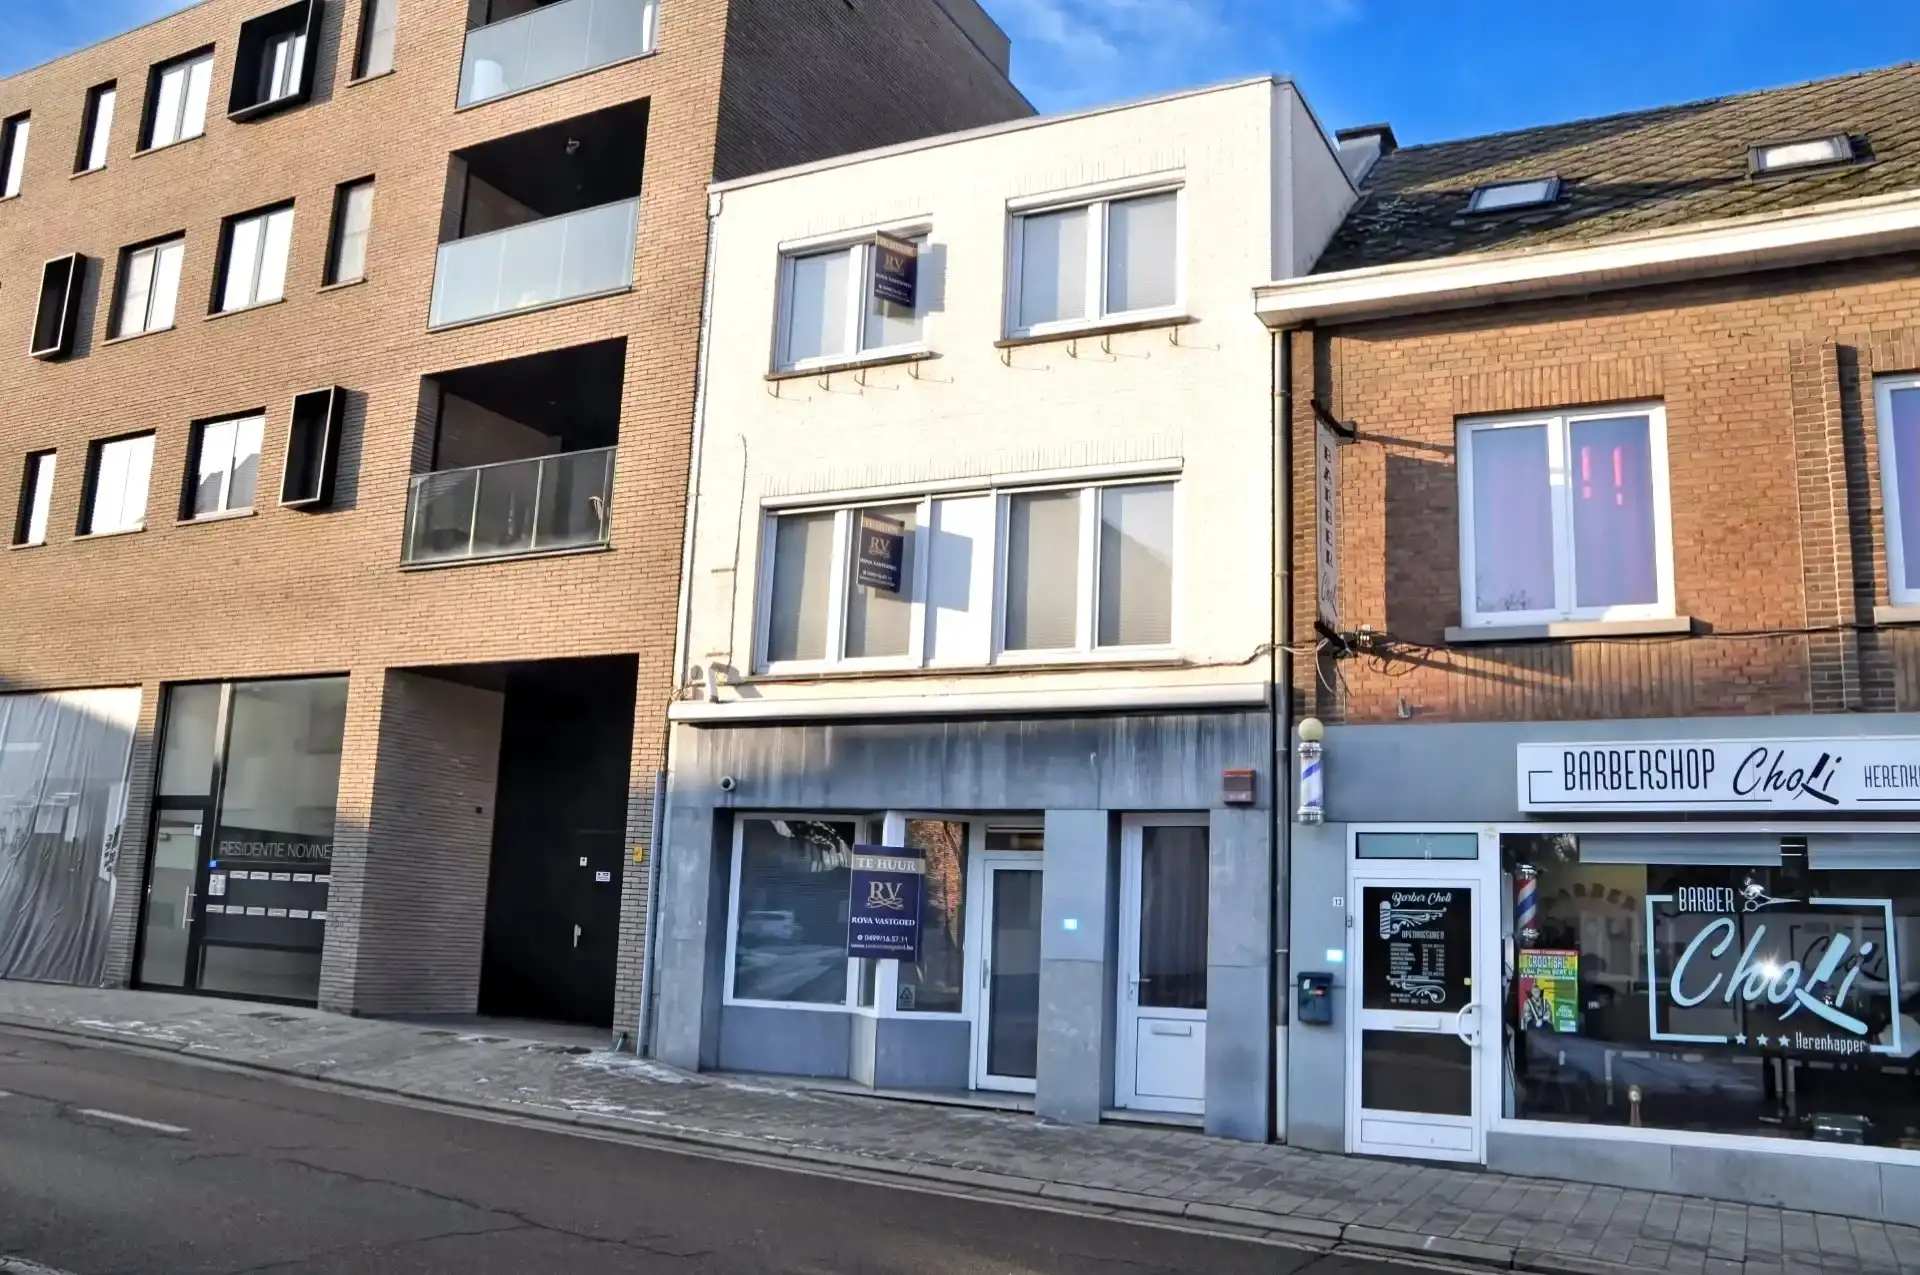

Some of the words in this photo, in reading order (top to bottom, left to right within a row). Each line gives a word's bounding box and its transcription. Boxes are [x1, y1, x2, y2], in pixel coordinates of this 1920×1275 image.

[884, 254, 903, 270] RV
[869, 536, 890, 552] RV
[1563, 748, 1715, 791] BARBERSHOP
[219, 840, 285, 857] RESIDENTIE
[857, 857, 873, 869] TE
[876, 859, 916, 872] HUUR
[868, 881, 903, 900] RV
[1391, 891, 1426, 907] Barber
[1678, 886, 1735, 912] BARBER
[851, 916, 873, 925] ROVA
[875, 917, 916, 926] VASTGOED
[1795, 1031, 1867, 1056] Herenkapper
